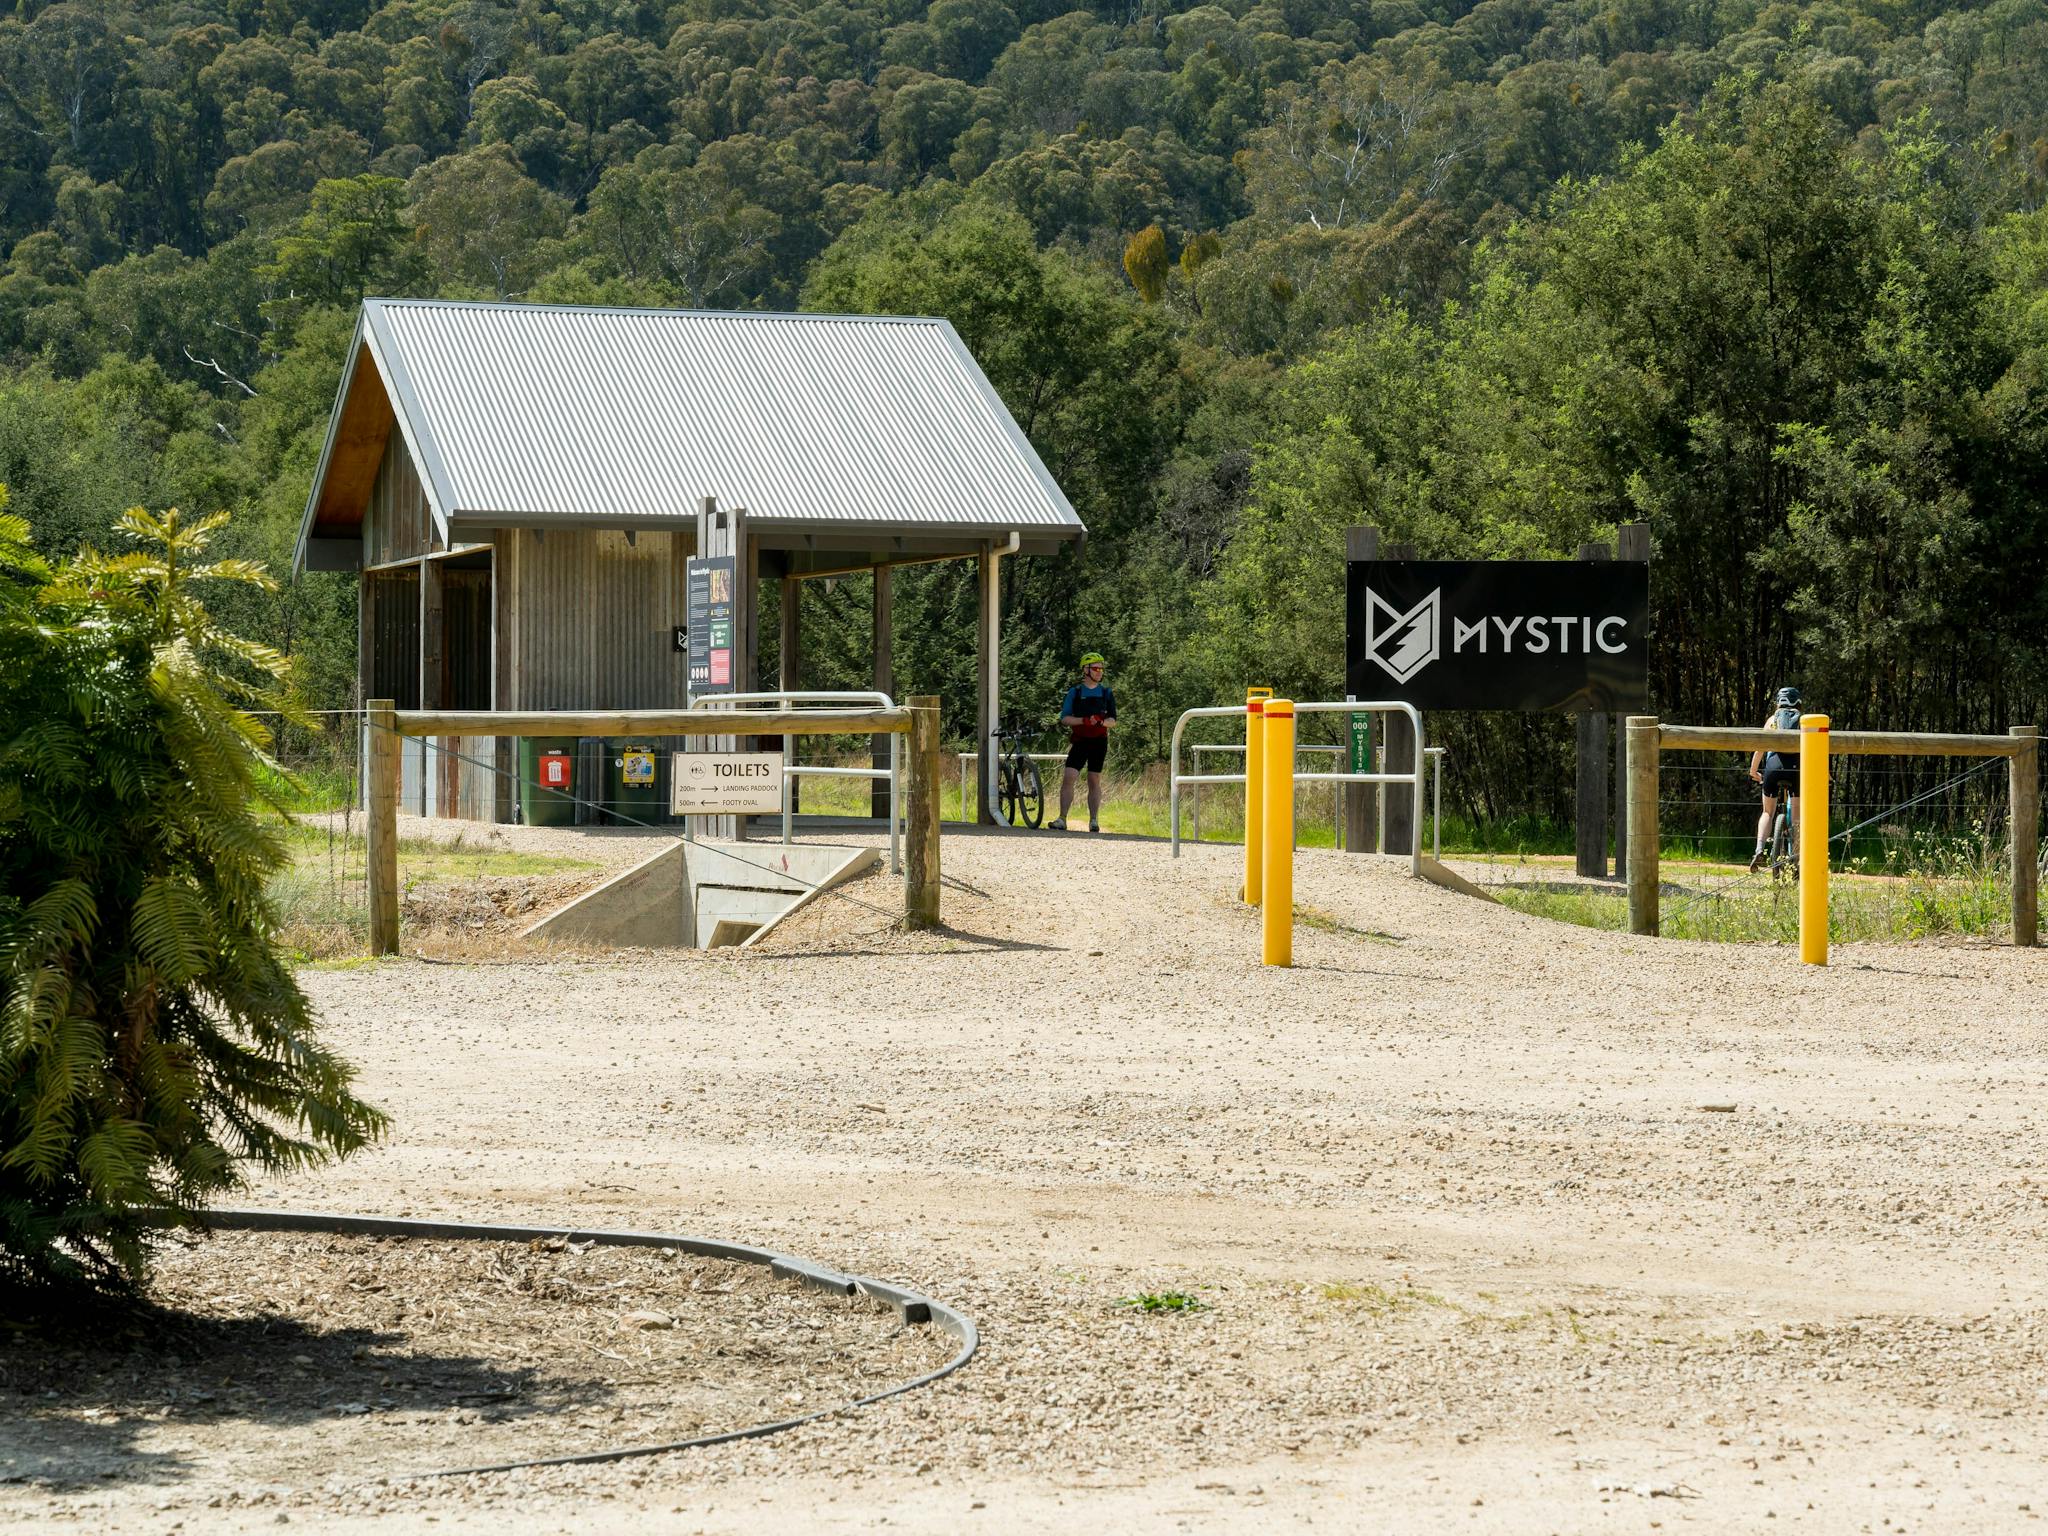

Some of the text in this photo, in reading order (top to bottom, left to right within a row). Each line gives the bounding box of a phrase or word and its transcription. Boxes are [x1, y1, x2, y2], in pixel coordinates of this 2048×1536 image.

[1454, 616, 1628, 653] MYSTIC
[1352, 722, 1368, 730] 000
[713, 764, 770, 776] TOILETS
